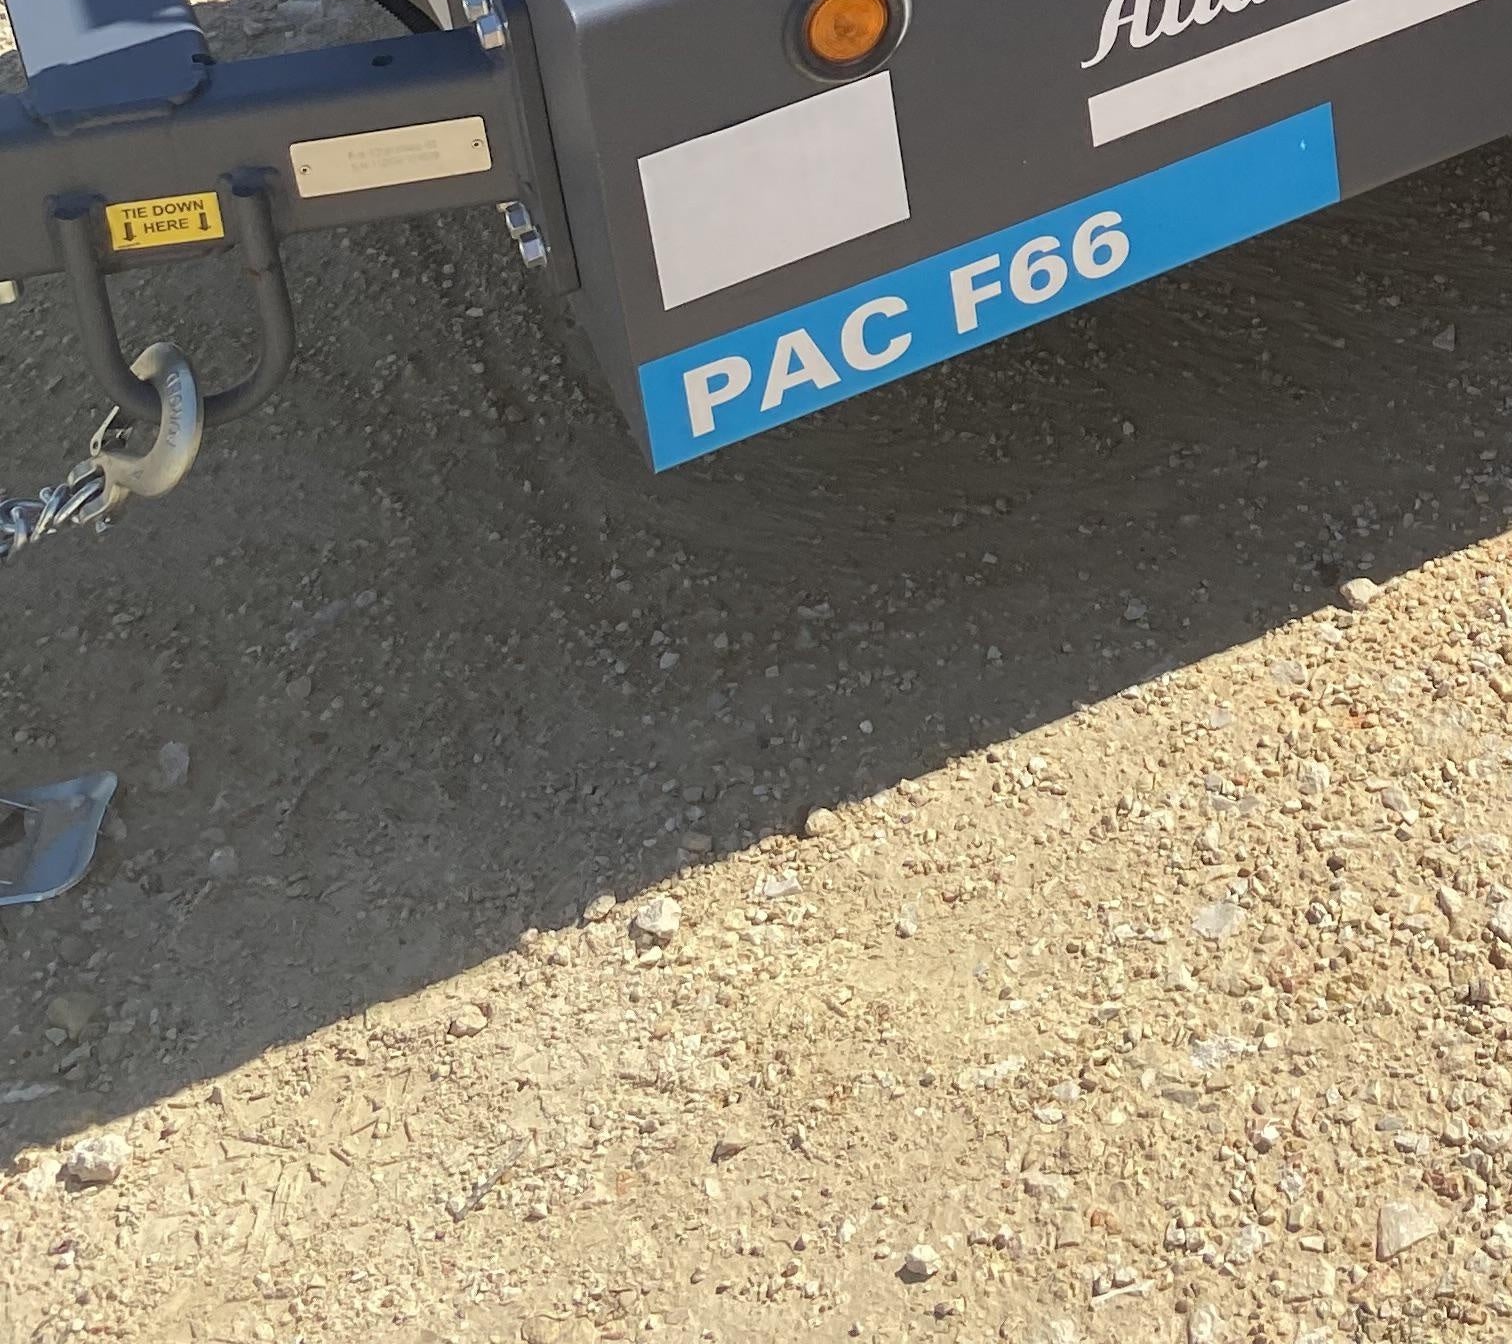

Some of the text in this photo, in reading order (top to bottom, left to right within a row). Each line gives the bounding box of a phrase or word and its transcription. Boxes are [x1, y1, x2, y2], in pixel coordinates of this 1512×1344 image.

[121, 198, 205, 221] TIE DOWN
[143, 218, 190, 235] HERE
[682, 210, 1132, 439] PAC F66
